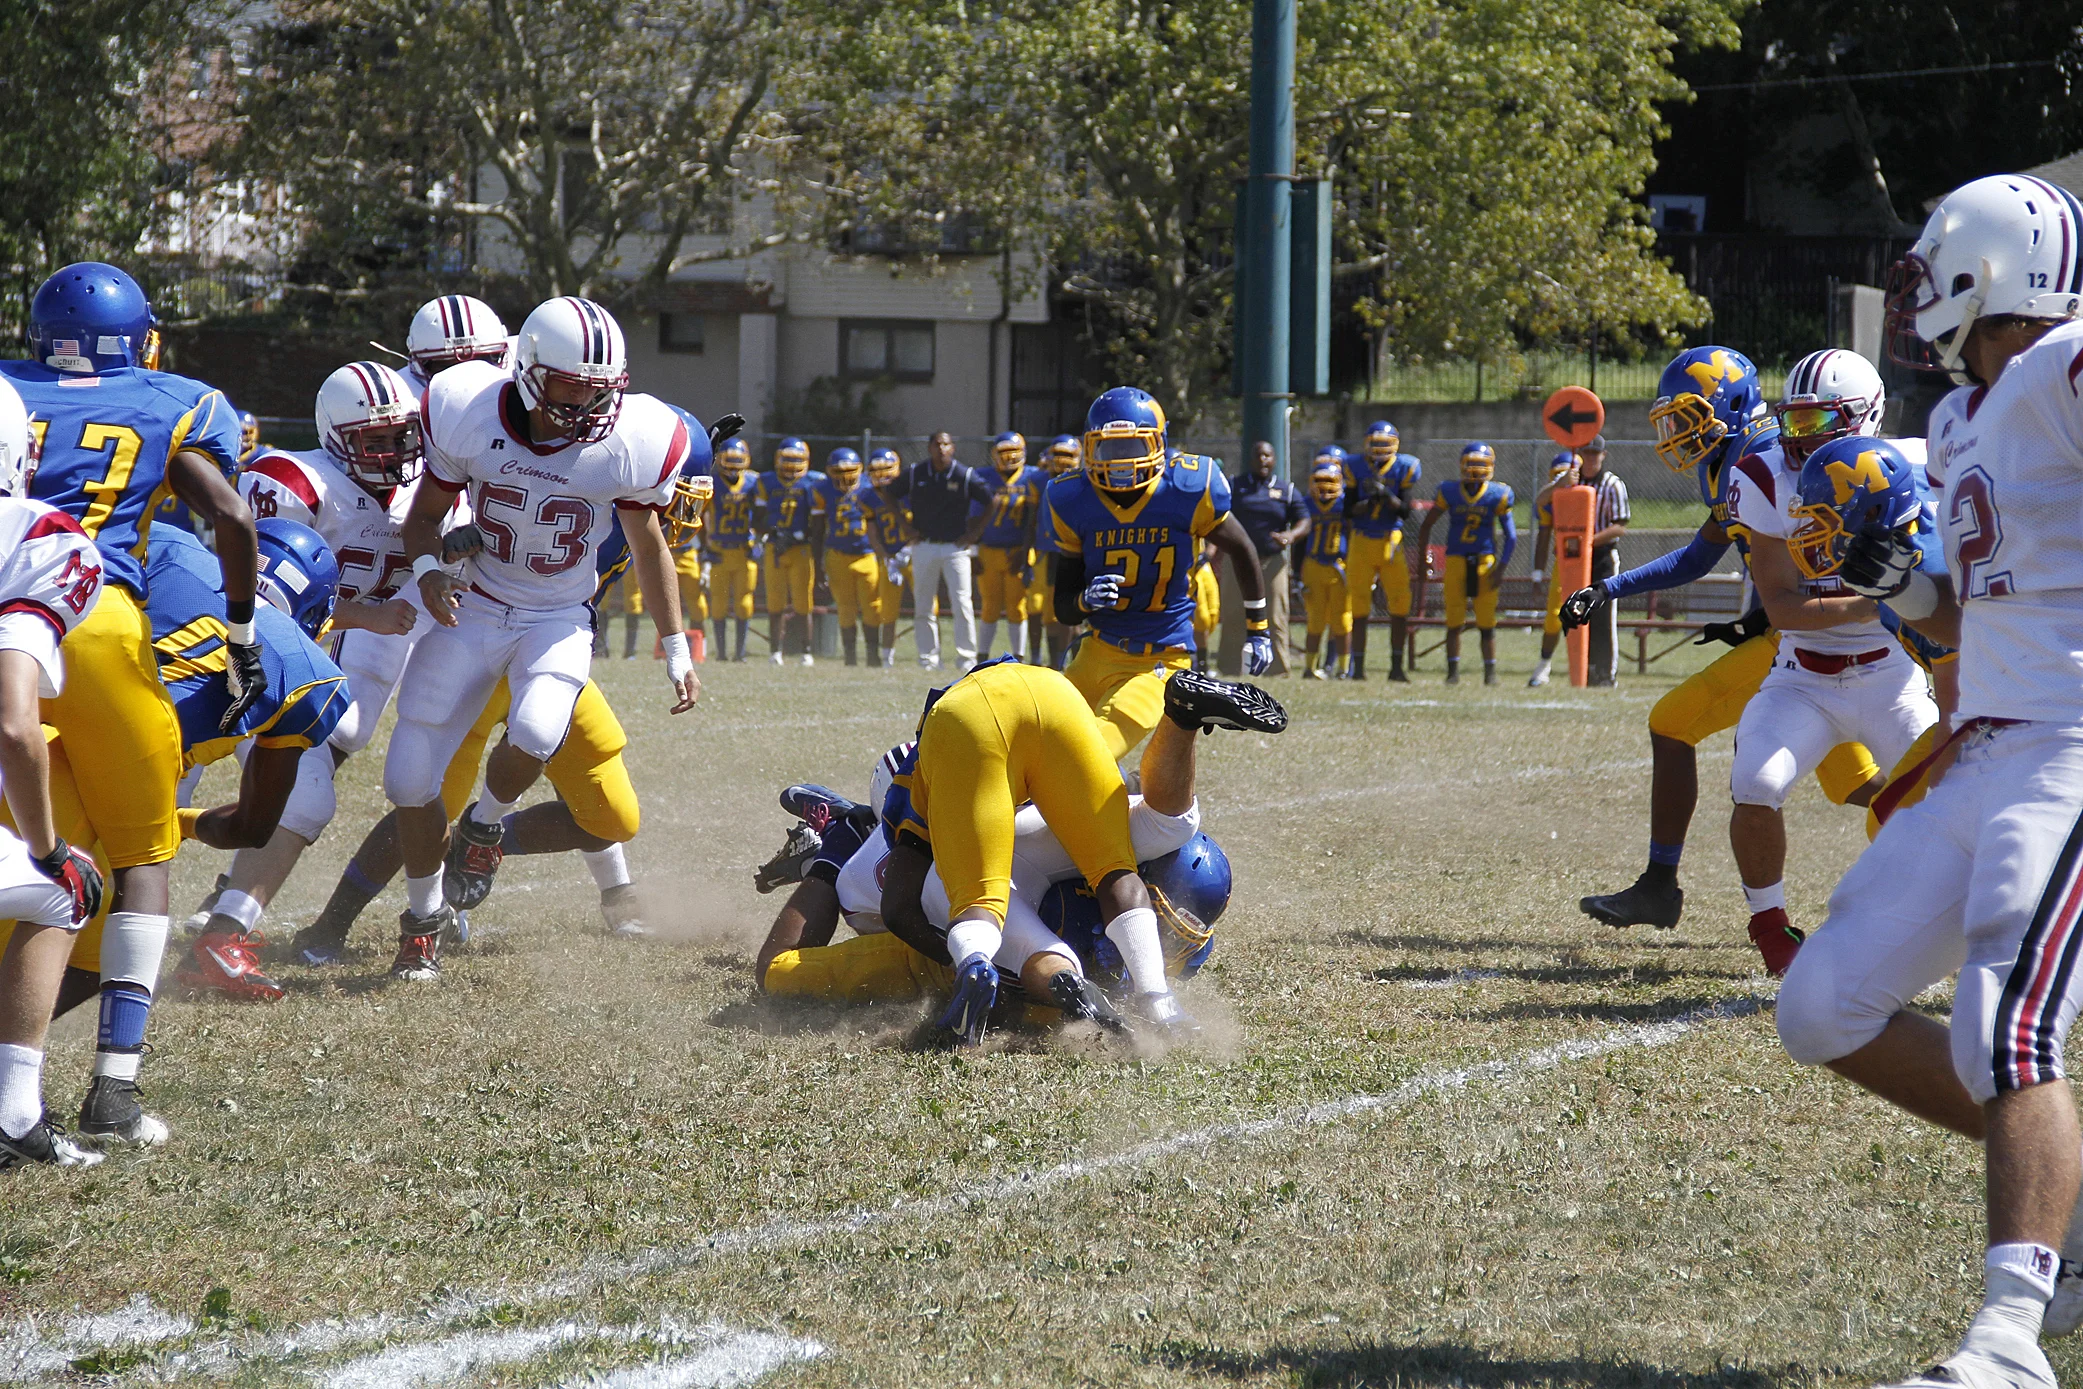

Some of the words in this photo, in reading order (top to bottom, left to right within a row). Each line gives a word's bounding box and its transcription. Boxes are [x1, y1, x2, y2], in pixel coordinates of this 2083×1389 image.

[2028, 273, 2048, 288] 12
[1685, 350, 1745, 398] M
[499, 459, 570, 485] Crimson
[1824, 449, 1890, 505] M
[474, 481, 595, 578] 53
[1095, 526, 1170, 548] KNIGHTS
[1460, 513, 1482, 544] 2
[1949, 464, 2016, 606] 2
[1103, 546, 1177, 613] 21
